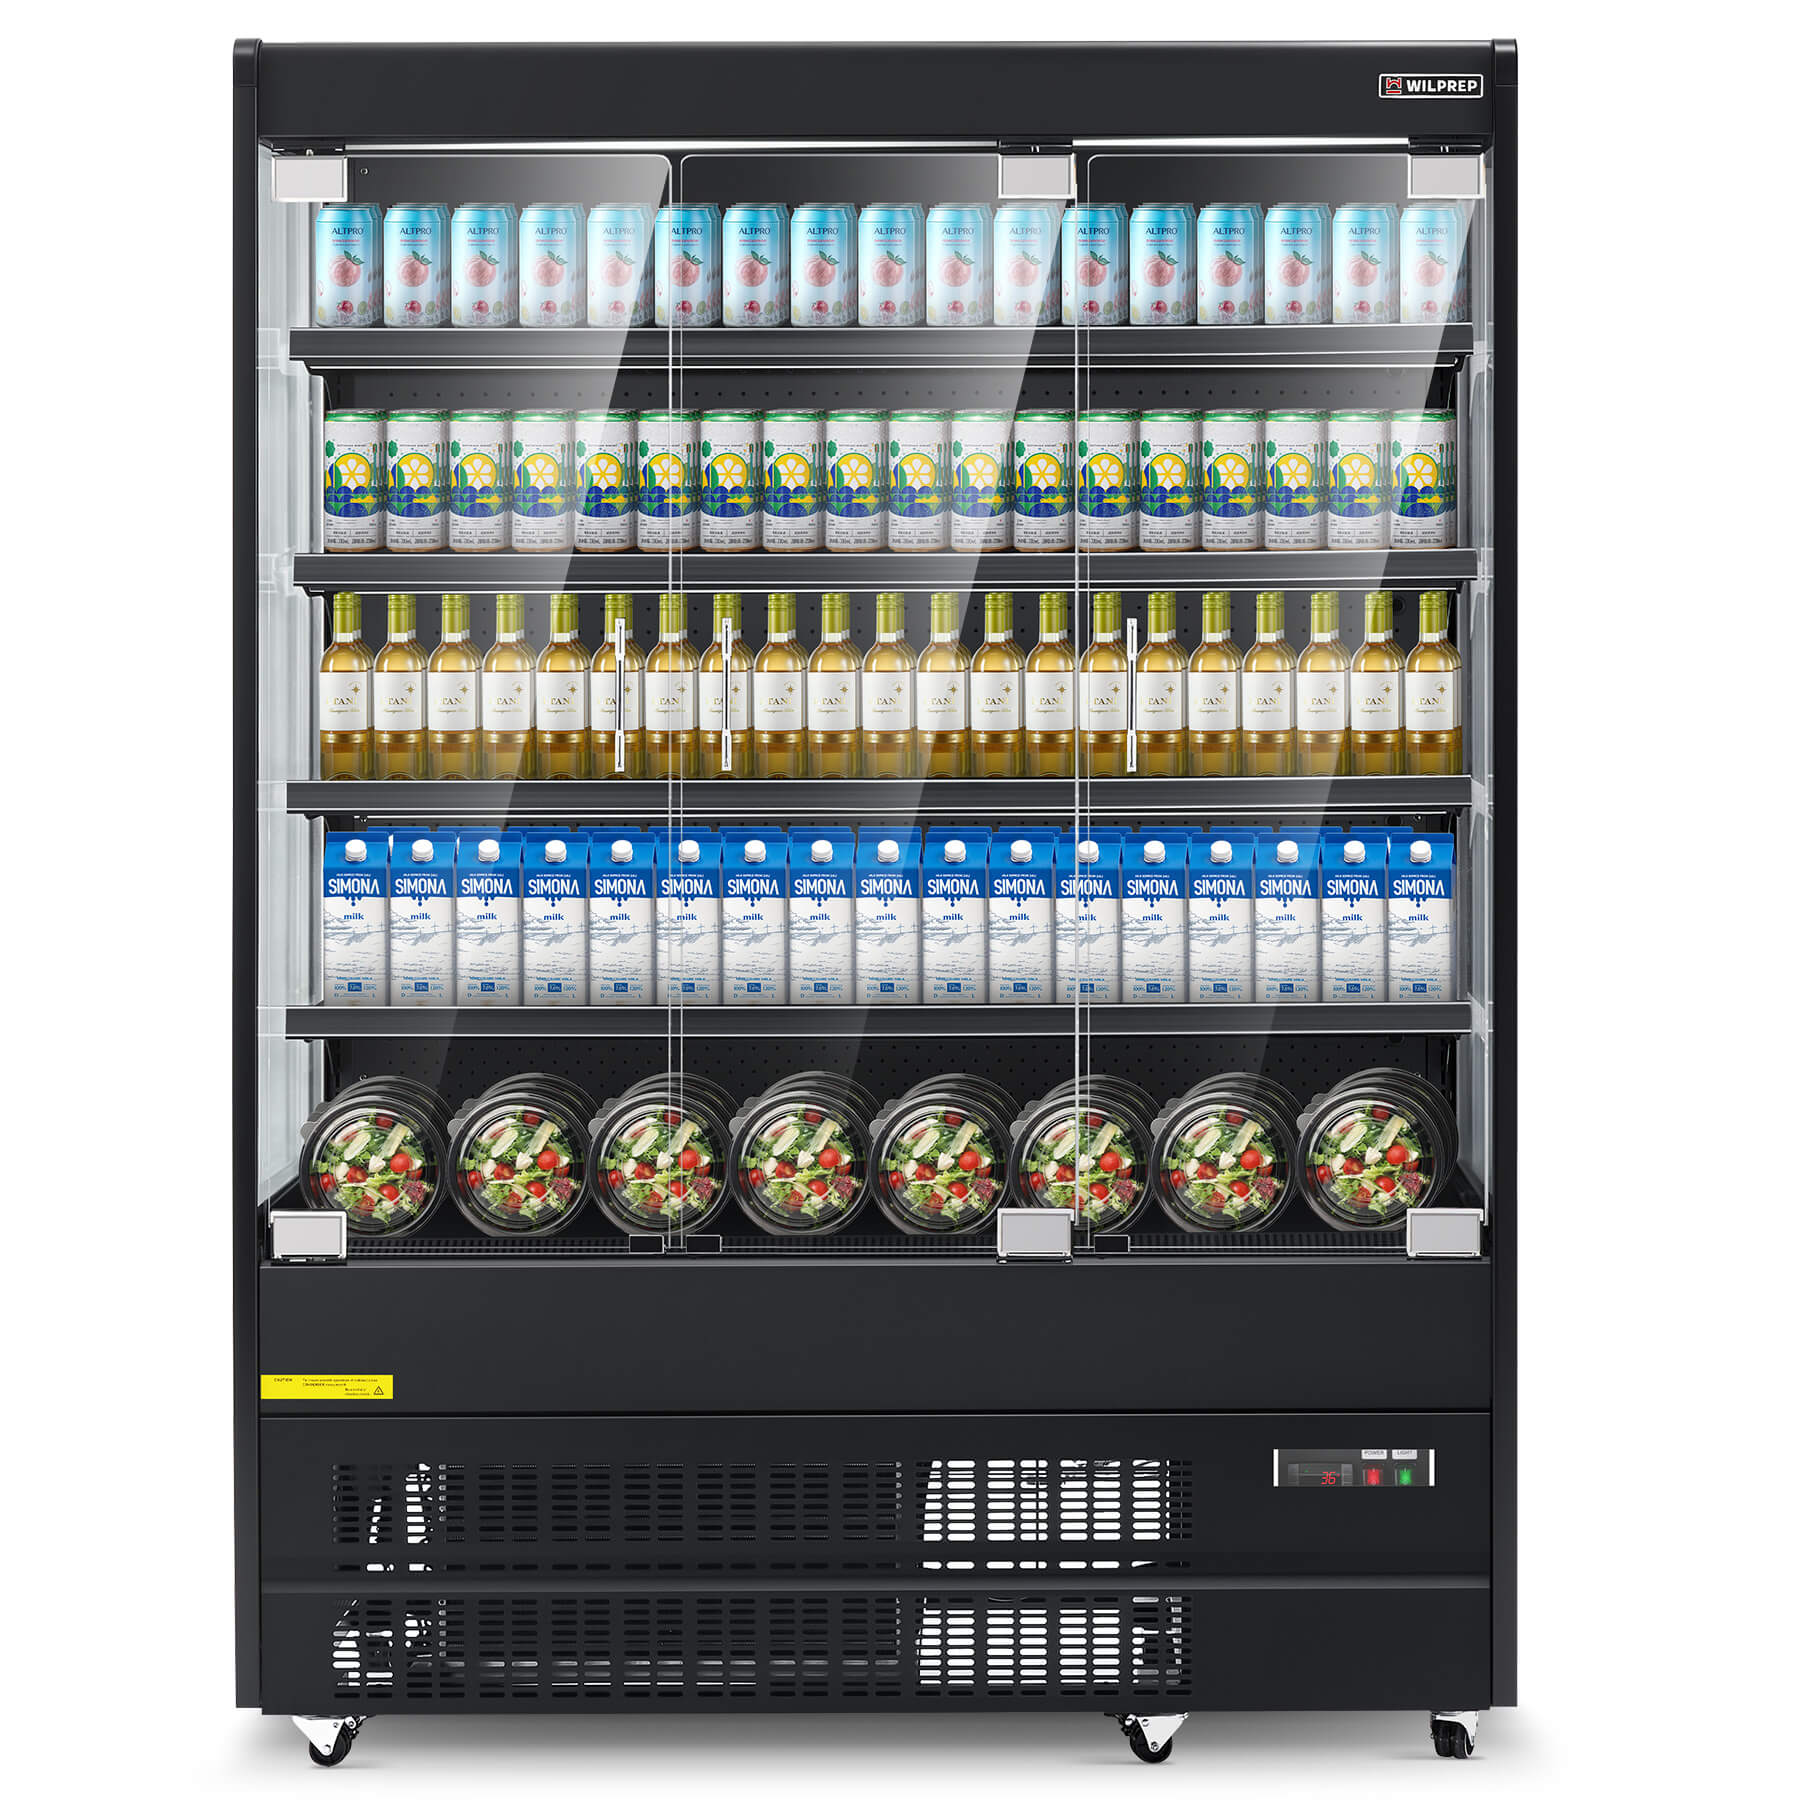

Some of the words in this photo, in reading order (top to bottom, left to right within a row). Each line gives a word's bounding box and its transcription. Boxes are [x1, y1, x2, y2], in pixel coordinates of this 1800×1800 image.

[1407, 79, 1478, 92] WILPREP
[328, 878, 380, 895] SIMONA
[395, 878, 447, 895] SIMONA
[461, 878, 513, 895] SIMONA
[528, 879, 580, 895] SIMONA
[594, 879, 646, 895] SIMONA
[661, 879, 713, 895] SIMONA
[727, 879, 779, 895] SIMONA
[794, 879, 846, 895] SIMONA
[860, 879, 912, 895] SIMONA
[927, 879, 979, 895] SIMONA
[994, 879, 1046, 895] SIMONA
[1060, 879, 1112, 896] SIMONA
[1127, 879, 1179, 896] SIMONA
[1194, 879, 1246, 896] SIMONA
[1260, 879, 1312, 896] SIMONA
[1327, 879, 1379, 896] SIMONA
[1393, 879, 1445, 896] SIMONA
[344, 912, 364, 920] milk
[411, 912, 431, 920] milk
[477, 912, 497, 920] milk
[1143, 913, 1163, 921] milk
[1210, 913, 1230, 921] milk
[1276, 913, 1296, 921] milk
[1343, 913, 1363, 921] milk
[1409, 913, 1429, 921] milk
[1321, 1471, 1336, 1485] 36
